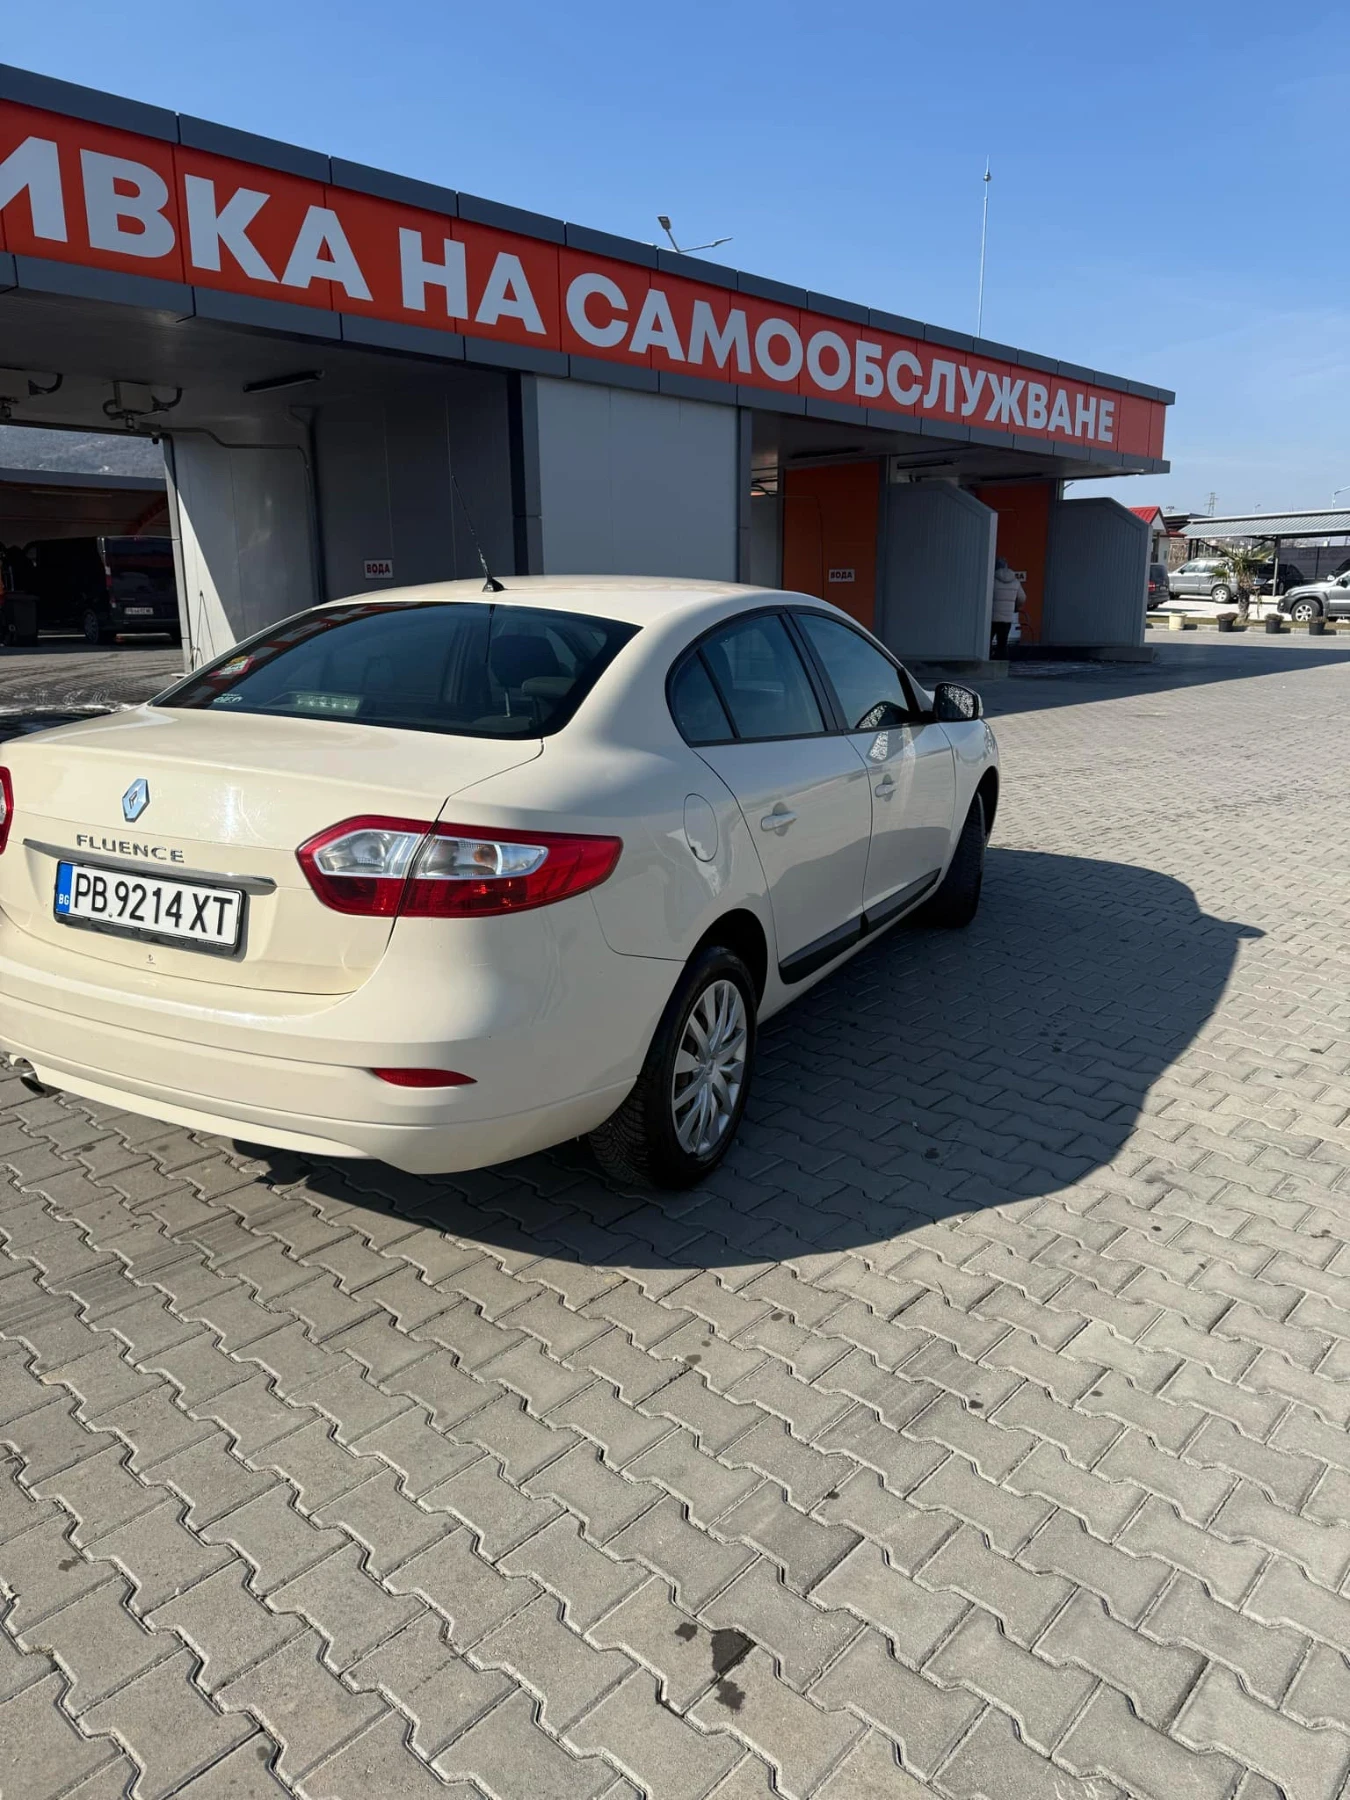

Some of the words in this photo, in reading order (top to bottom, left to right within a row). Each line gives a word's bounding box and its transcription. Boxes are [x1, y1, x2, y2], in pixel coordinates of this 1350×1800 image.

[399, 227, 547, 335] НА
[566, 272, 1115, 443] САМООБСЛУЖВАНЕ
[366, 563, 391, 575] ВОДА
[830, 571, 853, 580] ВОДА
[77, 835, 184, 863] FLUENCE
[58, 893, 70, 905] BG
